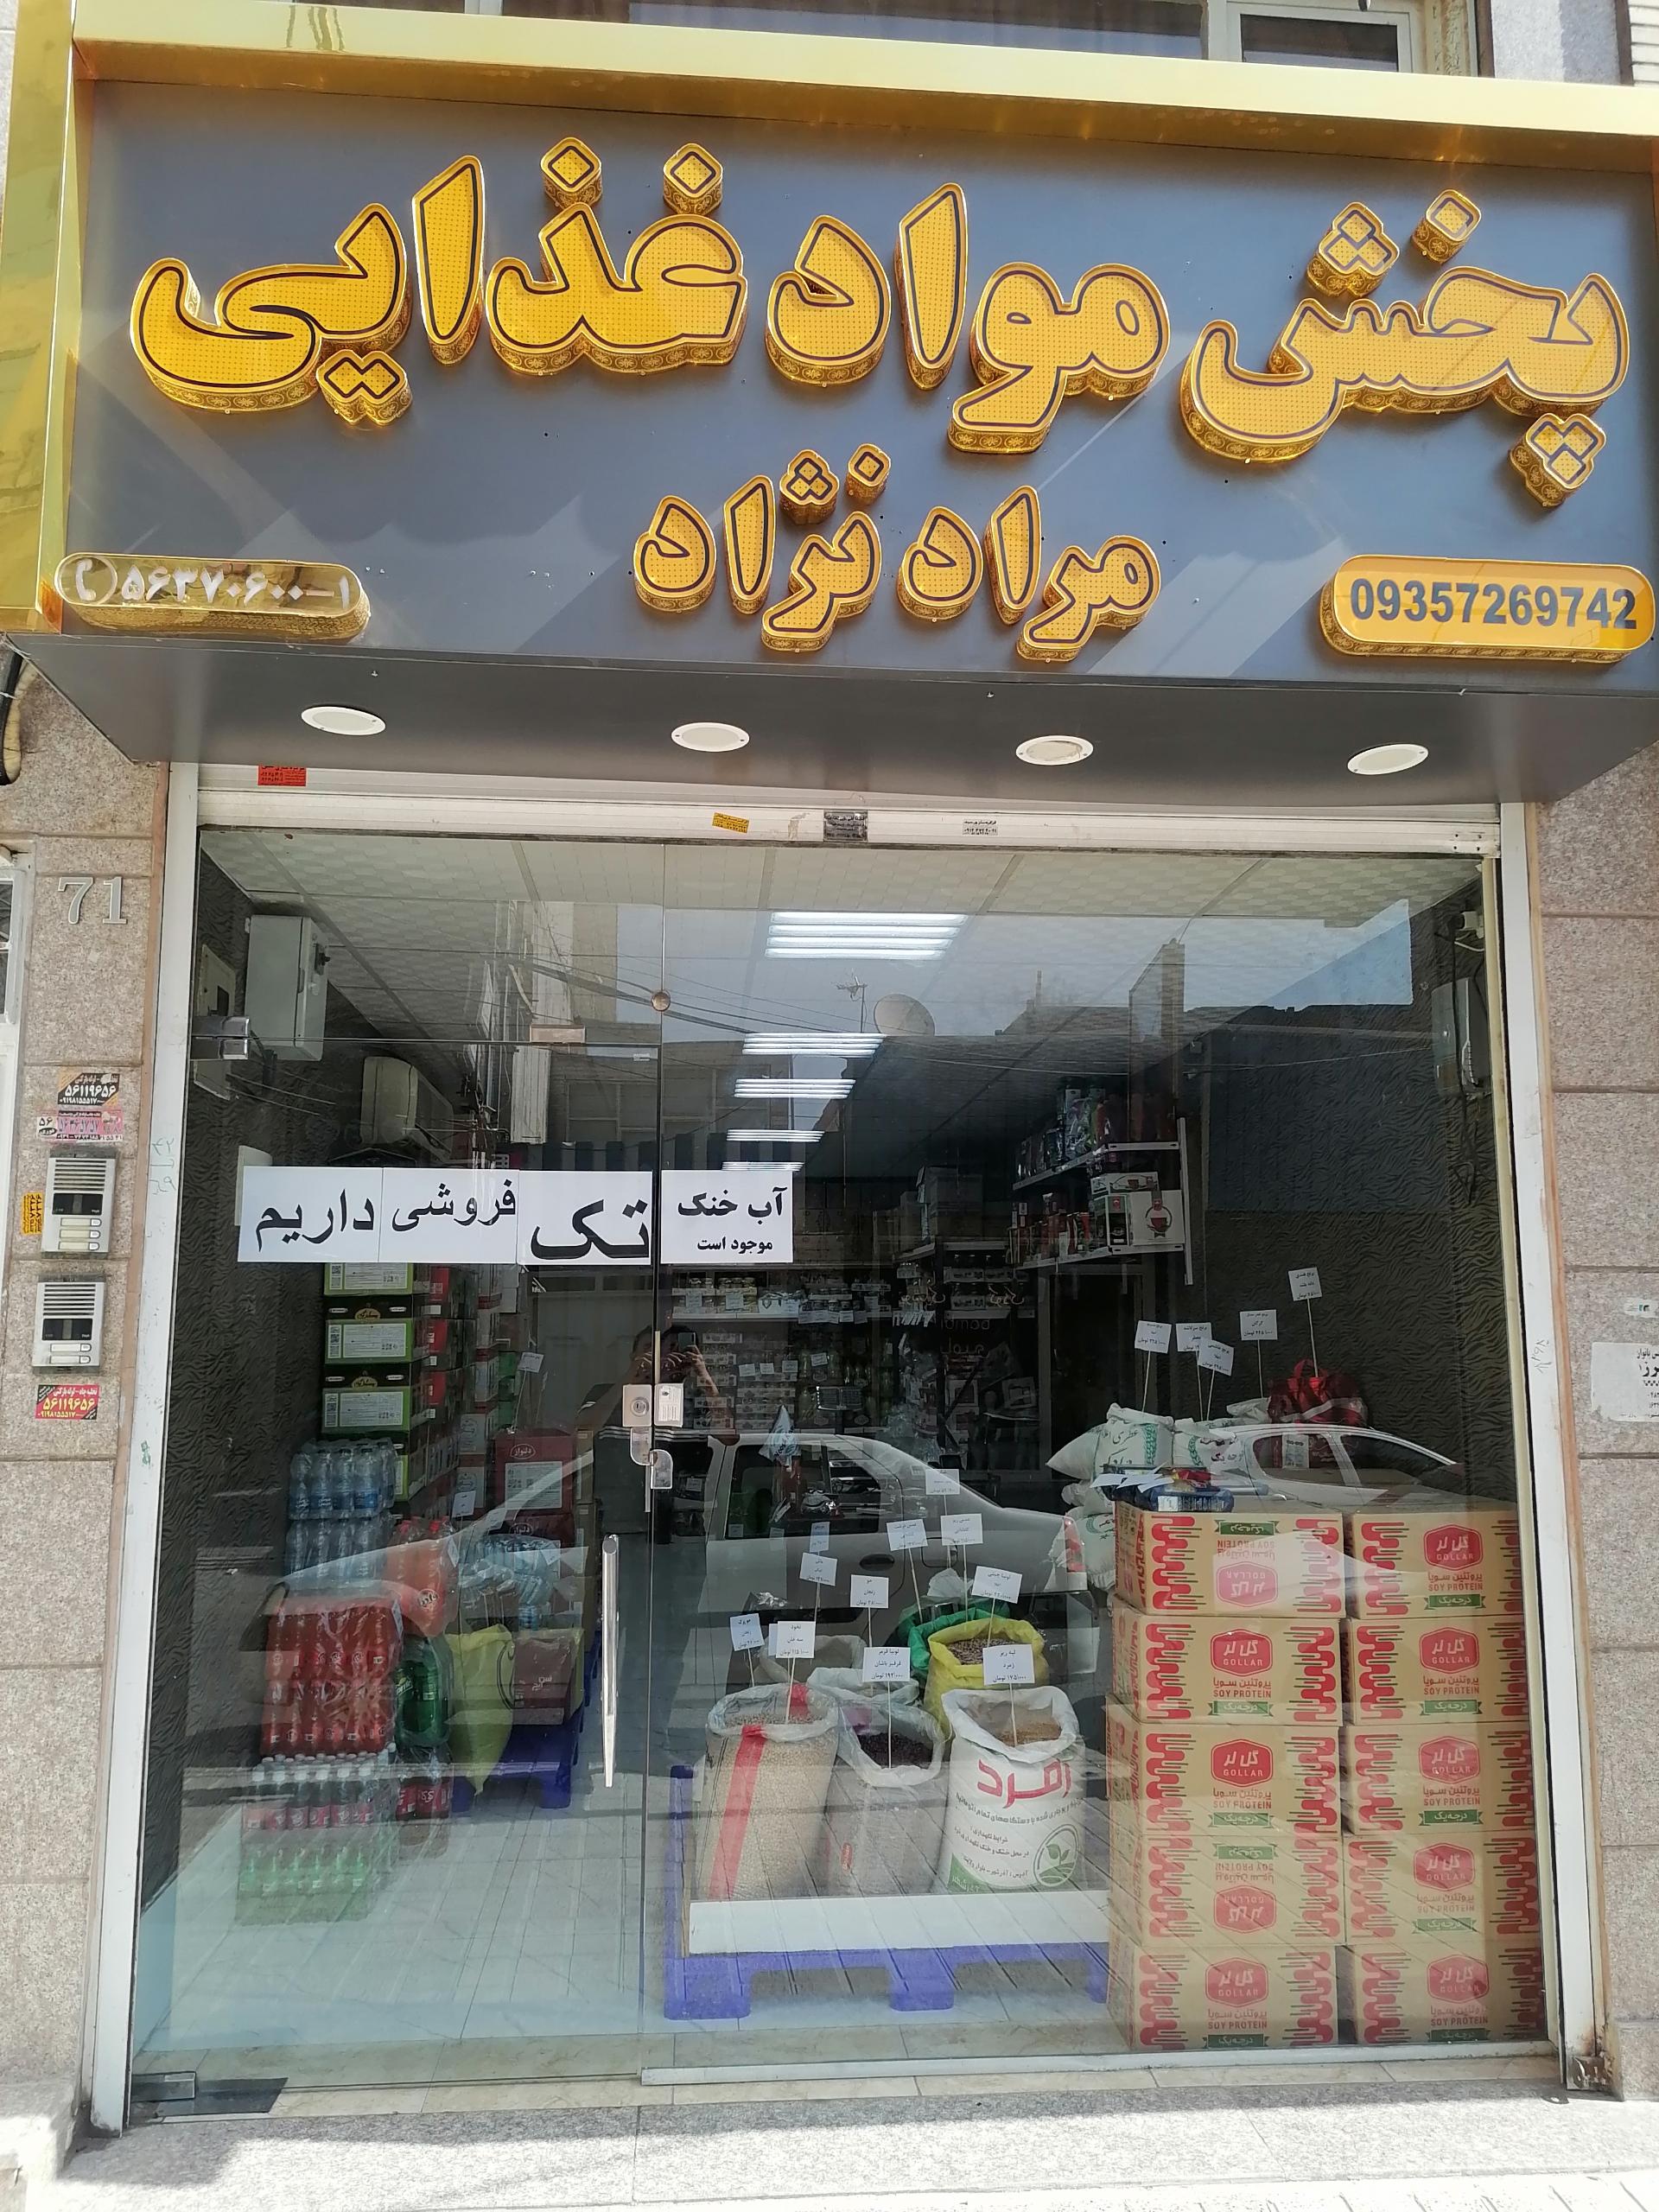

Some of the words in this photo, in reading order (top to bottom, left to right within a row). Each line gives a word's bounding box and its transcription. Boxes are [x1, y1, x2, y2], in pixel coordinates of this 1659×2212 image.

[130, 137, 747, 425] غذایی
[766, 183, 1170, 454] مواد
[1179, 188, 1630, 506] پخش
[633, 443, 890, 652] نژاد
[898, 485, 1160, 662] مراد
[1351, 578, 1637, 629] 09357269742
[57, 876, 127, 925] 71
[65, 1084, 116, 1097] ۵۶۱۱۹۶۵۶
[391, 1179, 516, 1232] فروشی
[677, 1189, 739, 1217] خنک
[747, 1186, 788, 1225] آب
[256, 1188, 375, 1252] داریم
[531, 1199, 649, 1260] تک
[697, 1236, 727, 1251] است
[730, 1240, 772, 1254] موجود
[42, 1397, 95, 1410] ۵۶۱۱۹۶۵۶
[1217, 1540, 1251, 1549] PROTEIN
[1256, 1540, 1275, 1549] SOY
[1427, 1573, 1451, 1582] سویا
[1452, 1572, 1483, 1583] پروتئین
[1213, 1676, 1236, 1688] سویا
[1239, 1678, 1271, 1689] پروتئین
[1423, 1675, 1446, 1687] سویا
[1448, 1675, 1479, 1687] پروتئین
[1233, 1689, 1271, 1698] PROTEIN
[1443, 1686, 1479, 1694] PROTEIN
[1213, 1788, 1236, 1799] سویا
[1239, 1789, 1271, 1801] پروتئین
[1423, 1785, 1446, 1797] سویا
[1448, 1785, 1480, 1796] پروتئین
[1216, 1863, 1254, 1872] PROTEIN
[1256, 1863, 1274, 1872] SOY
[1438, 1904, 1474, 1913] PROTEIN
[1208, 2009, 1231, 2020] سویا
[1235, 2009, 1267, 2020] پروتئین
[1208, 2021, 1226, 2030] SOY
[1229, 2021, 1268, 2030] PROTEIN
